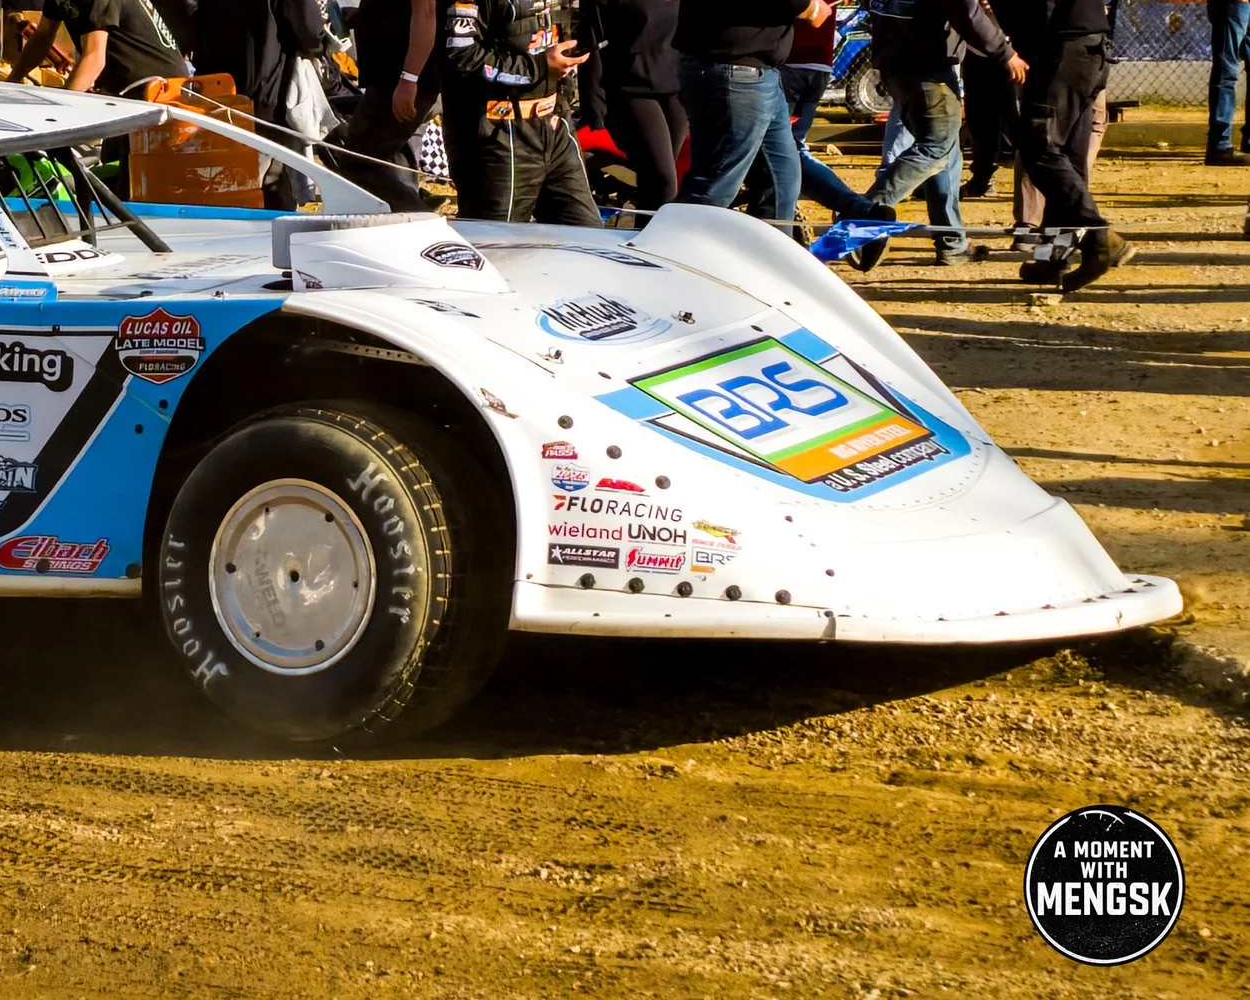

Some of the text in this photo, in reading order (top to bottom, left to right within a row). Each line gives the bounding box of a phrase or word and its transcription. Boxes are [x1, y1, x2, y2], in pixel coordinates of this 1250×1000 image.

[126, 320, 192, 335] LUCAS OIL
[115, 338, 205, 351] LATE MODEL
[676, 360, 850, 440] BRS
[855, 455, 900, 475] Steel
[547, 521, 623, 541] wieland
[627, 523, 687, 545] UNOH
[562, 548, 616, 558] ALLSTAR
[23, 560, 92, 570] SRINGS
